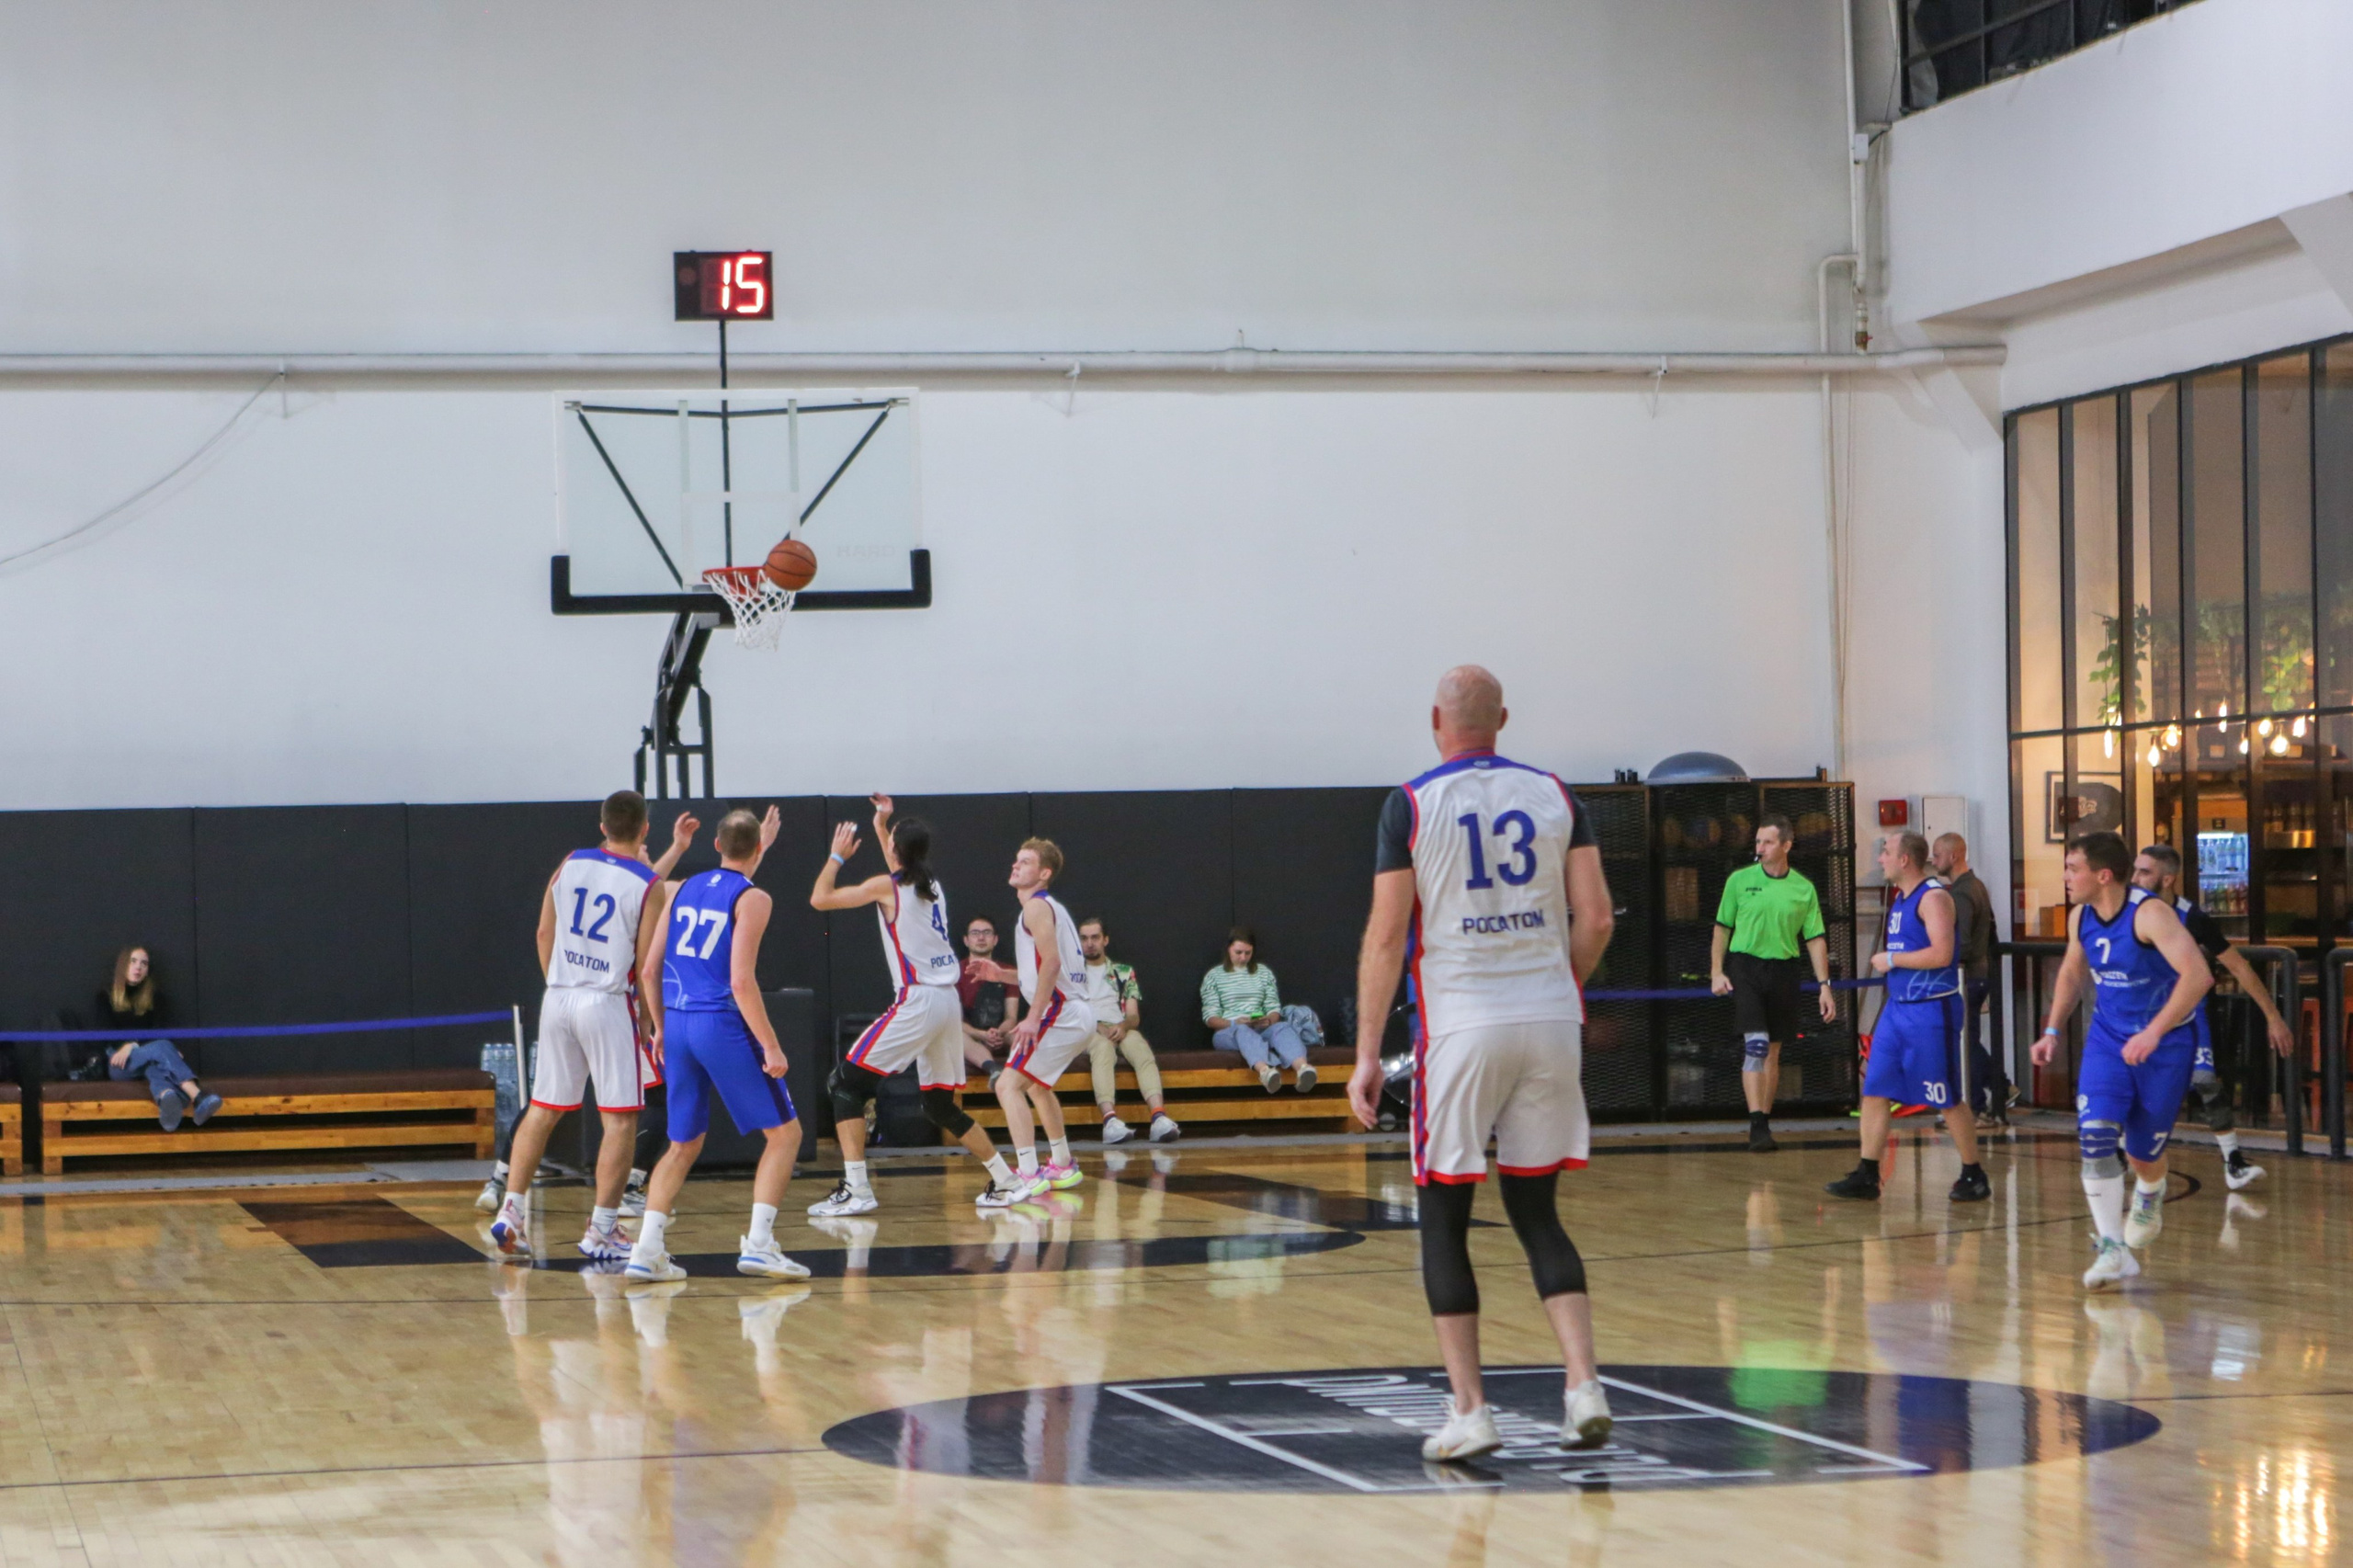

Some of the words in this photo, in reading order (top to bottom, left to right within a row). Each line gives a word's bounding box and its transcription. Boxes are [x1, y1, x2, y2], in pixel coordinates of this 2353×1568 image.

[721, 257, 764, 313] 15
[1458, 810, 1537, 891] 13
[570, 887, 616, 944] 12
[676, 906, 729, 960] 27
[1462, 910, 1545, 935] РОСАТОМ
[2095, 937, 2111, 964] 7
[1923, 1081, 1947, 1104] 30
[2149, 1131, 2168, 1155] 7
